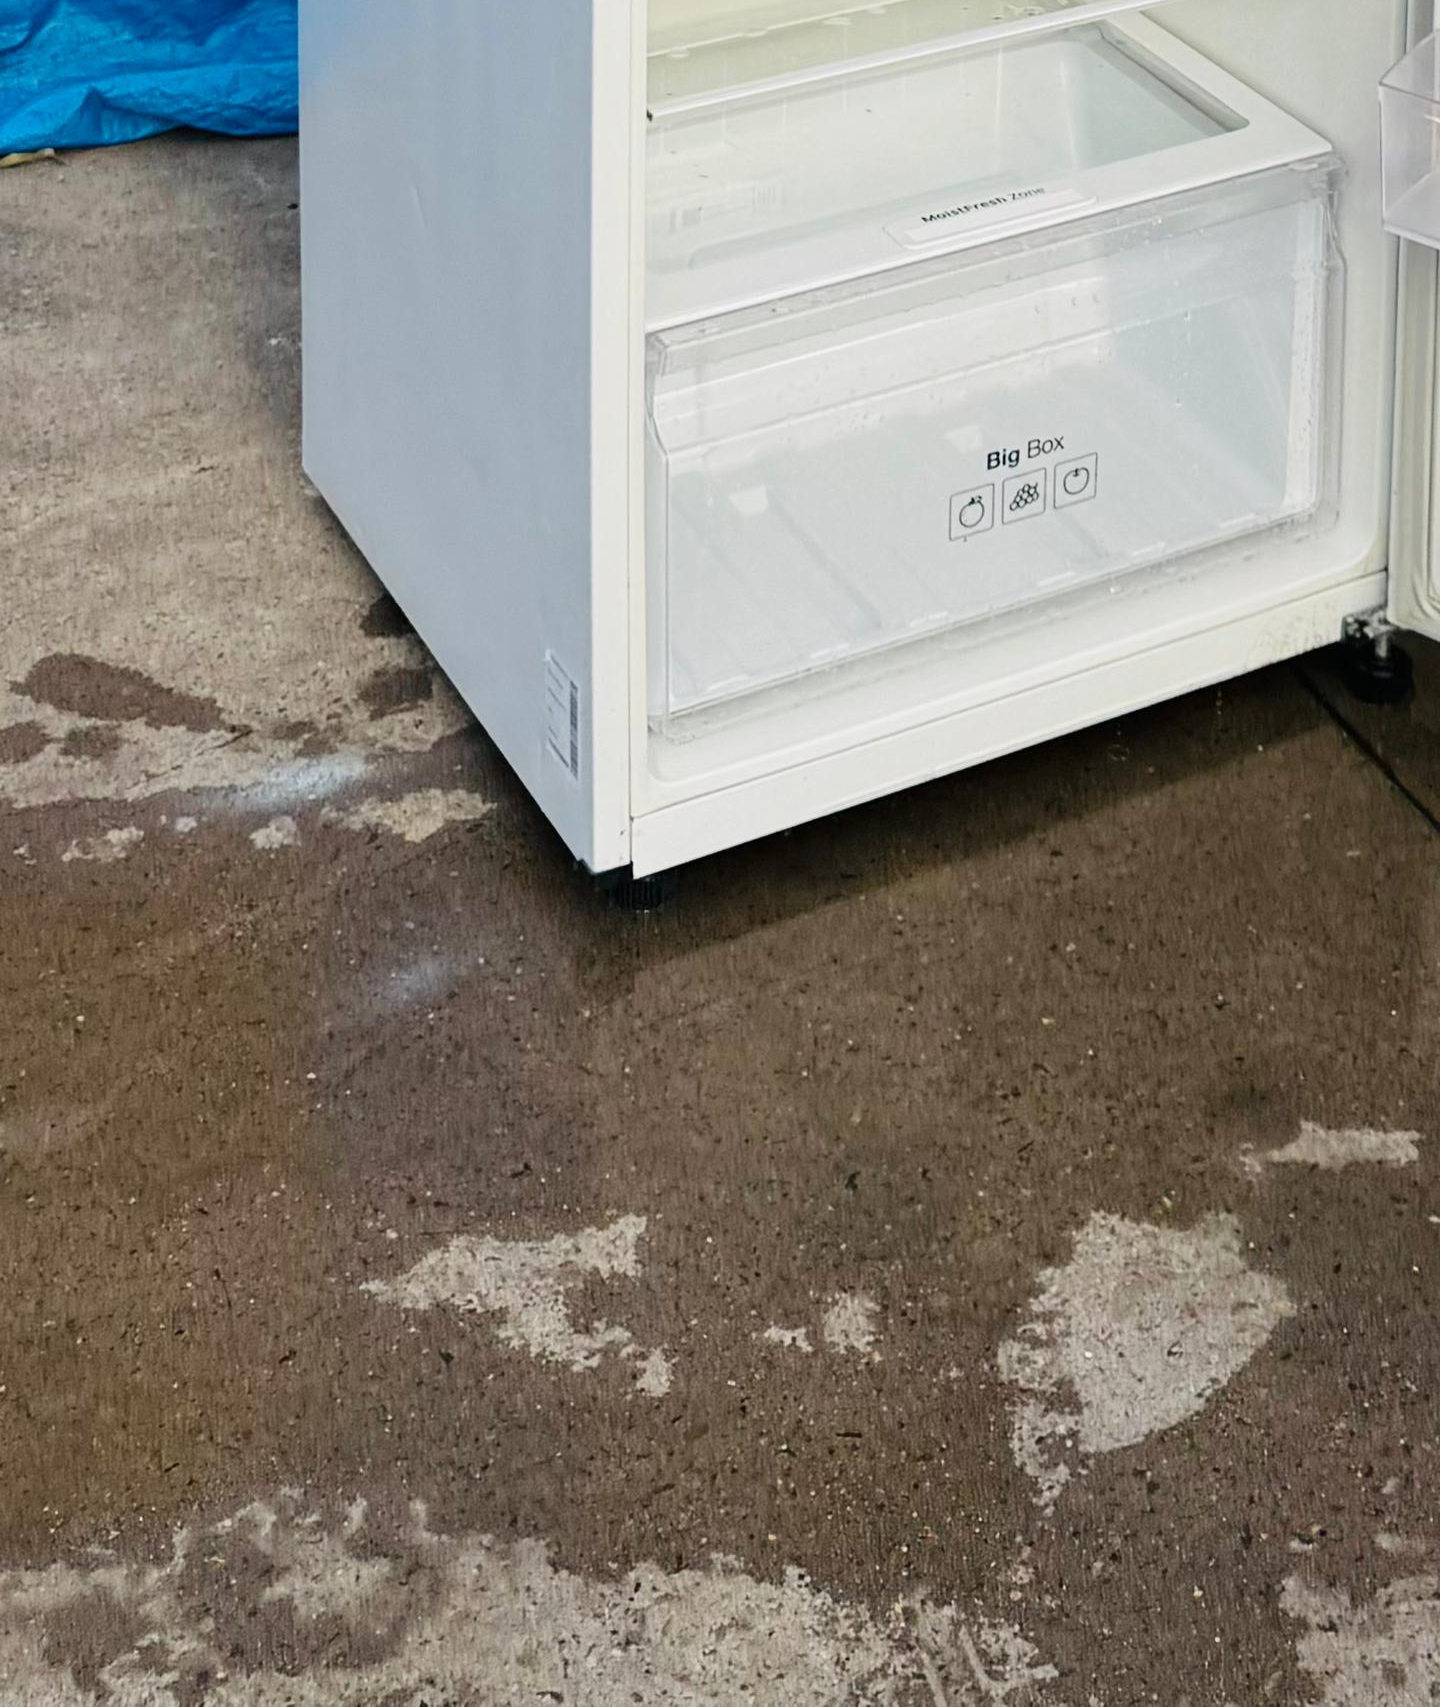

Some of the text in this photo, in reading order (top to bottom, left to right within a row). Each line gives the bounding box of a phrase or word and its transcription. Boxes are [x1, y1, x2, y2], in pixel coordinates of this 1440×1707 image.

[921, 186, 1047, 224] MoistFresh Zone
[986, 435, 1065, 471] Big Box
